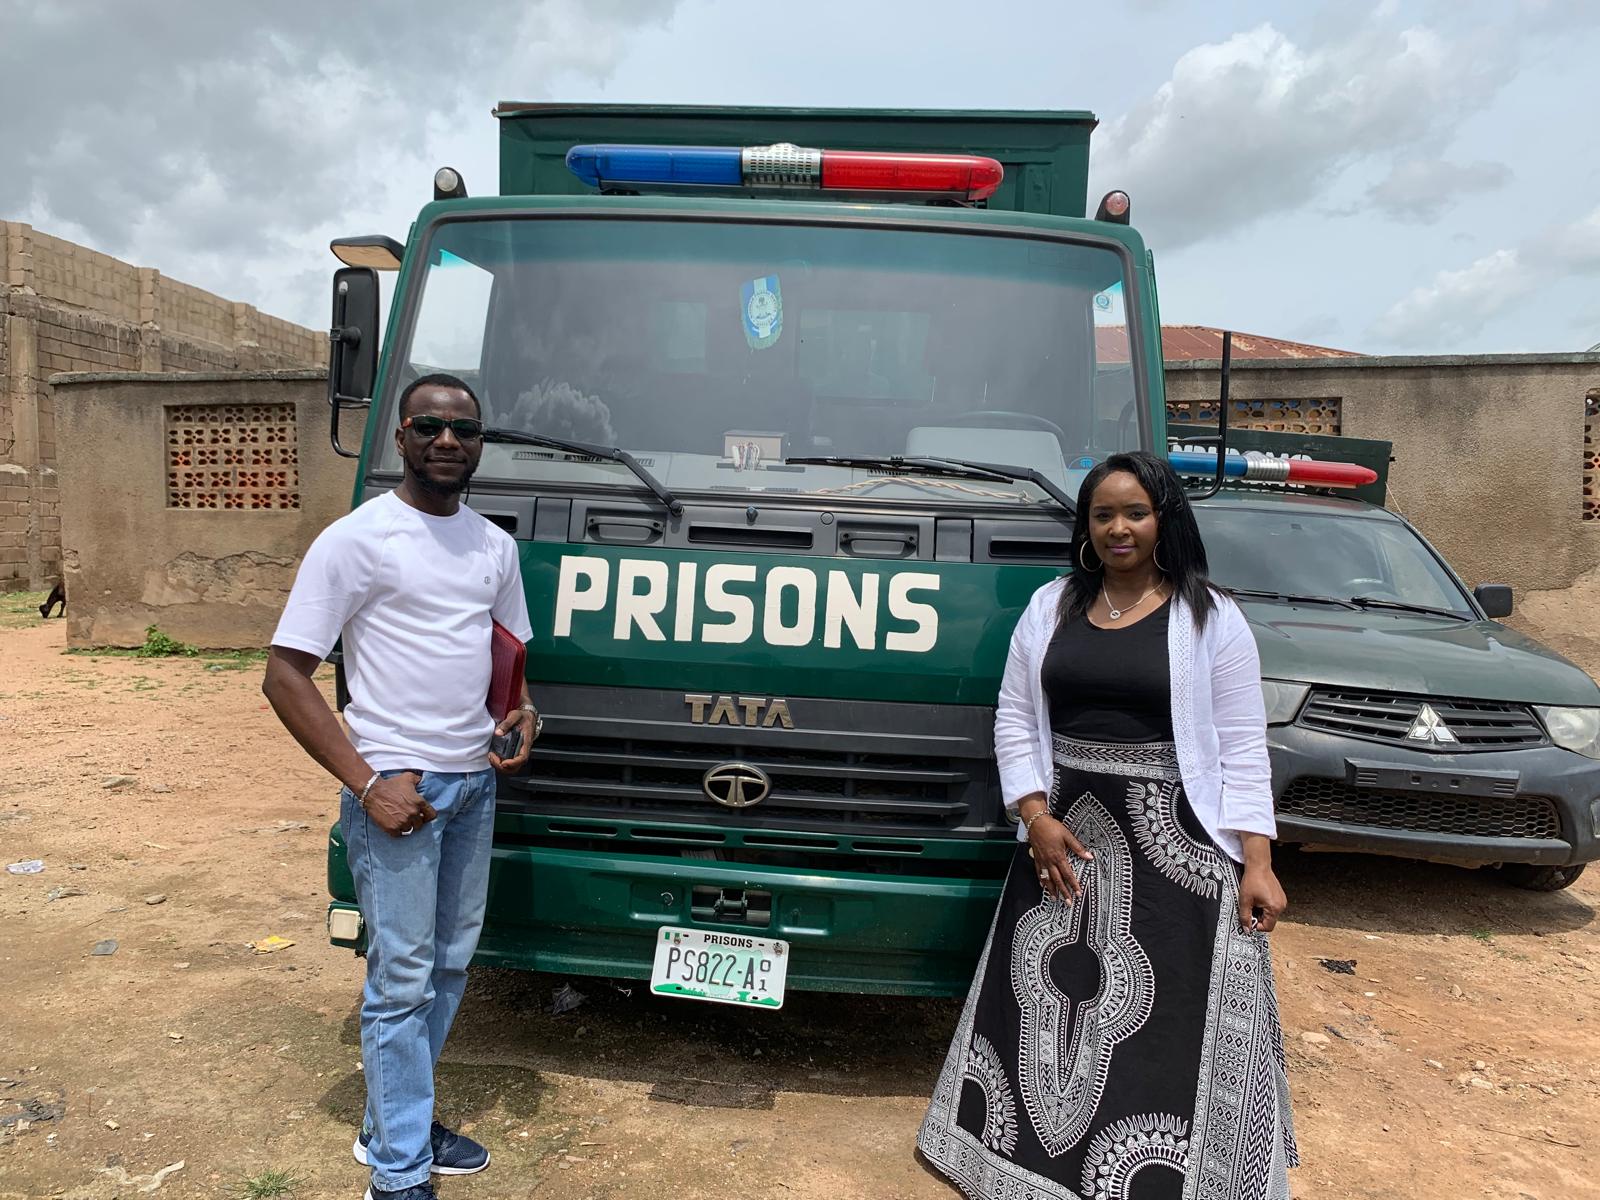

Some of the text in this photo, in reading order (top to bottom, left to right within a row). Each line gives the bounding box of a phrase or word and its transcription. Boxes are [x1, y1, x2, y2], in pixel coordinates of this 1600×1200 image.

[554, 555, 940, 652] PRISONS
[684, 694, 794, 728] TATA
[703, 933, 753, 948] PRISONS
